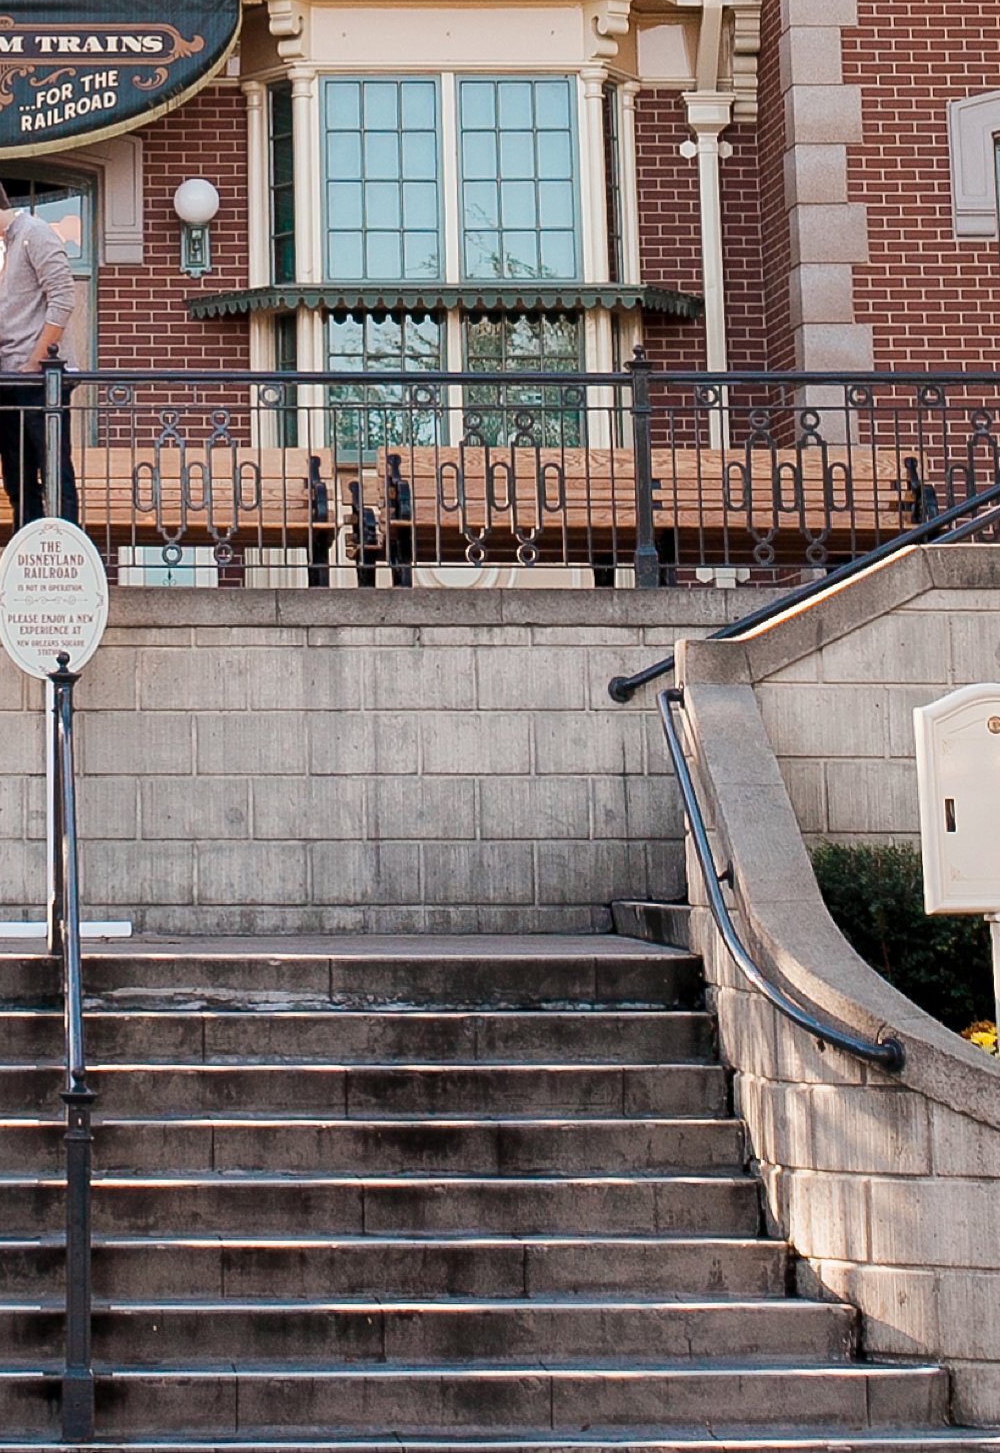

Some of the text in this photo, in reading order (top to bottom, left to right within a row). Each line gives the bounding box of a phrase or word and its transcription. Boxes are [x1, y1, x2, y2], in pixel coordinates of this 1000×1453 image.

[34, 35, 164, 53] TRAINS
[19, 69, 119, 112] ...FOR THE
[20, 91, 117, 132] RAILROAD
[40, 541, 62, 553] THE
[17, 554, 84, 566] DISNEYLAND
[24, 567, 78, 579] RAILROAD
[8, 614, 93, 623] PLEASE ENJOY A NEW
[20, 626, 81, 635] EXPERIENCE AT
